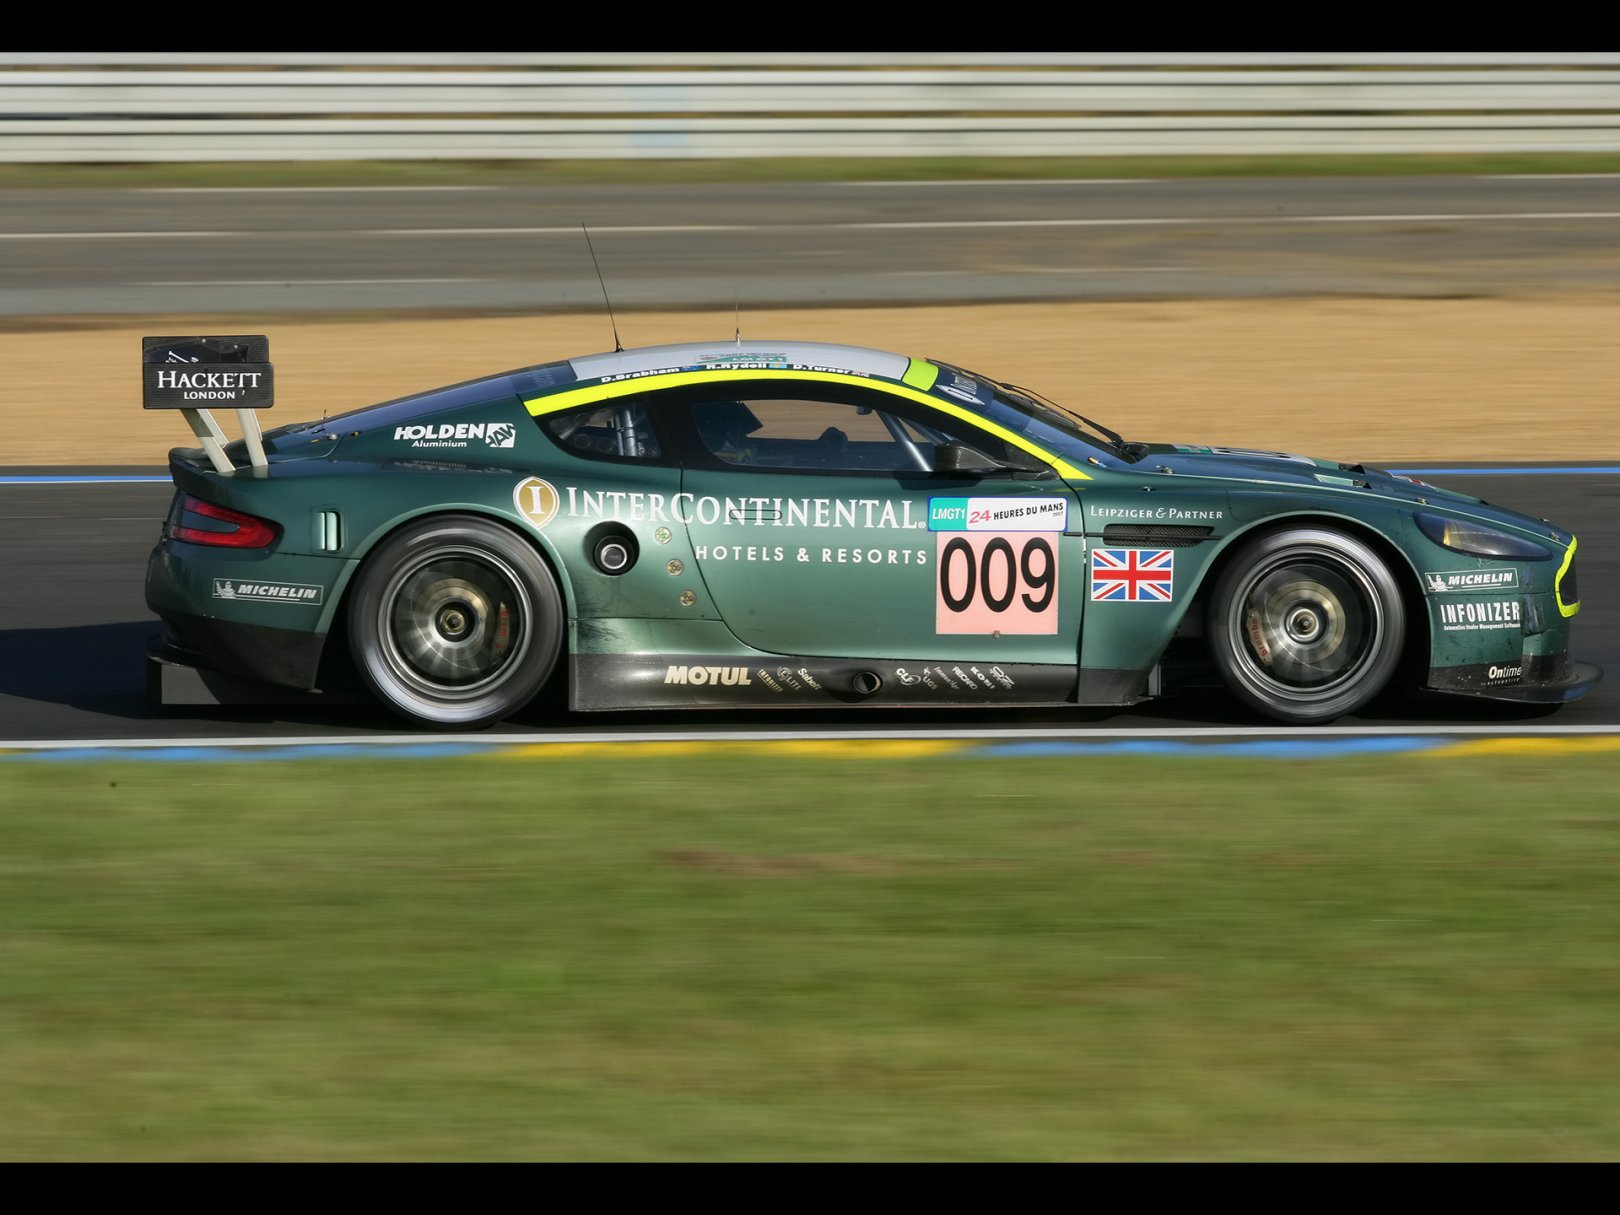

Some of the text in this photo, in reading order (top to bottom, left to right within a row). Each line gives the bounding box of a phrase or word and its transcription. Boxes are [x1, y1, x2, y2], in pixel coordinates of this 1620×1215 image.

[601, 367, 680, 383] D.Brabham
[793, 363, 851, 375] D.Turner
[157, 370, 261, 388] HACKETT
[183, 391, 236, 400] LONDON
[394, 423, 485, 440] HOLDEN
[411, 439, 467, 448] Aluminium
[566, 486, 918, 528] INTERCONTINENTAL
[932, 508, 966, 520] LMGT1
[969, 502, 1064, 524] 24 HEURES DU MANS
[1090, 505, 1223, 519] LEIPZIGER & PARTNER
[695, 545, 927, 565] HOTELS & RESORTS
[940, 536, 1056, 613] 009
[1448, 572, 1513, 586] MICHELIN
[237, 584, 317, 599] MICHELIN
[1440, 601, 1520, 623] INFONIZER
[664, 666, 752, 686] MOTUL
[952, 666, 978, 690] RECARO
[1488, 665, 1522, 679] Ontime
